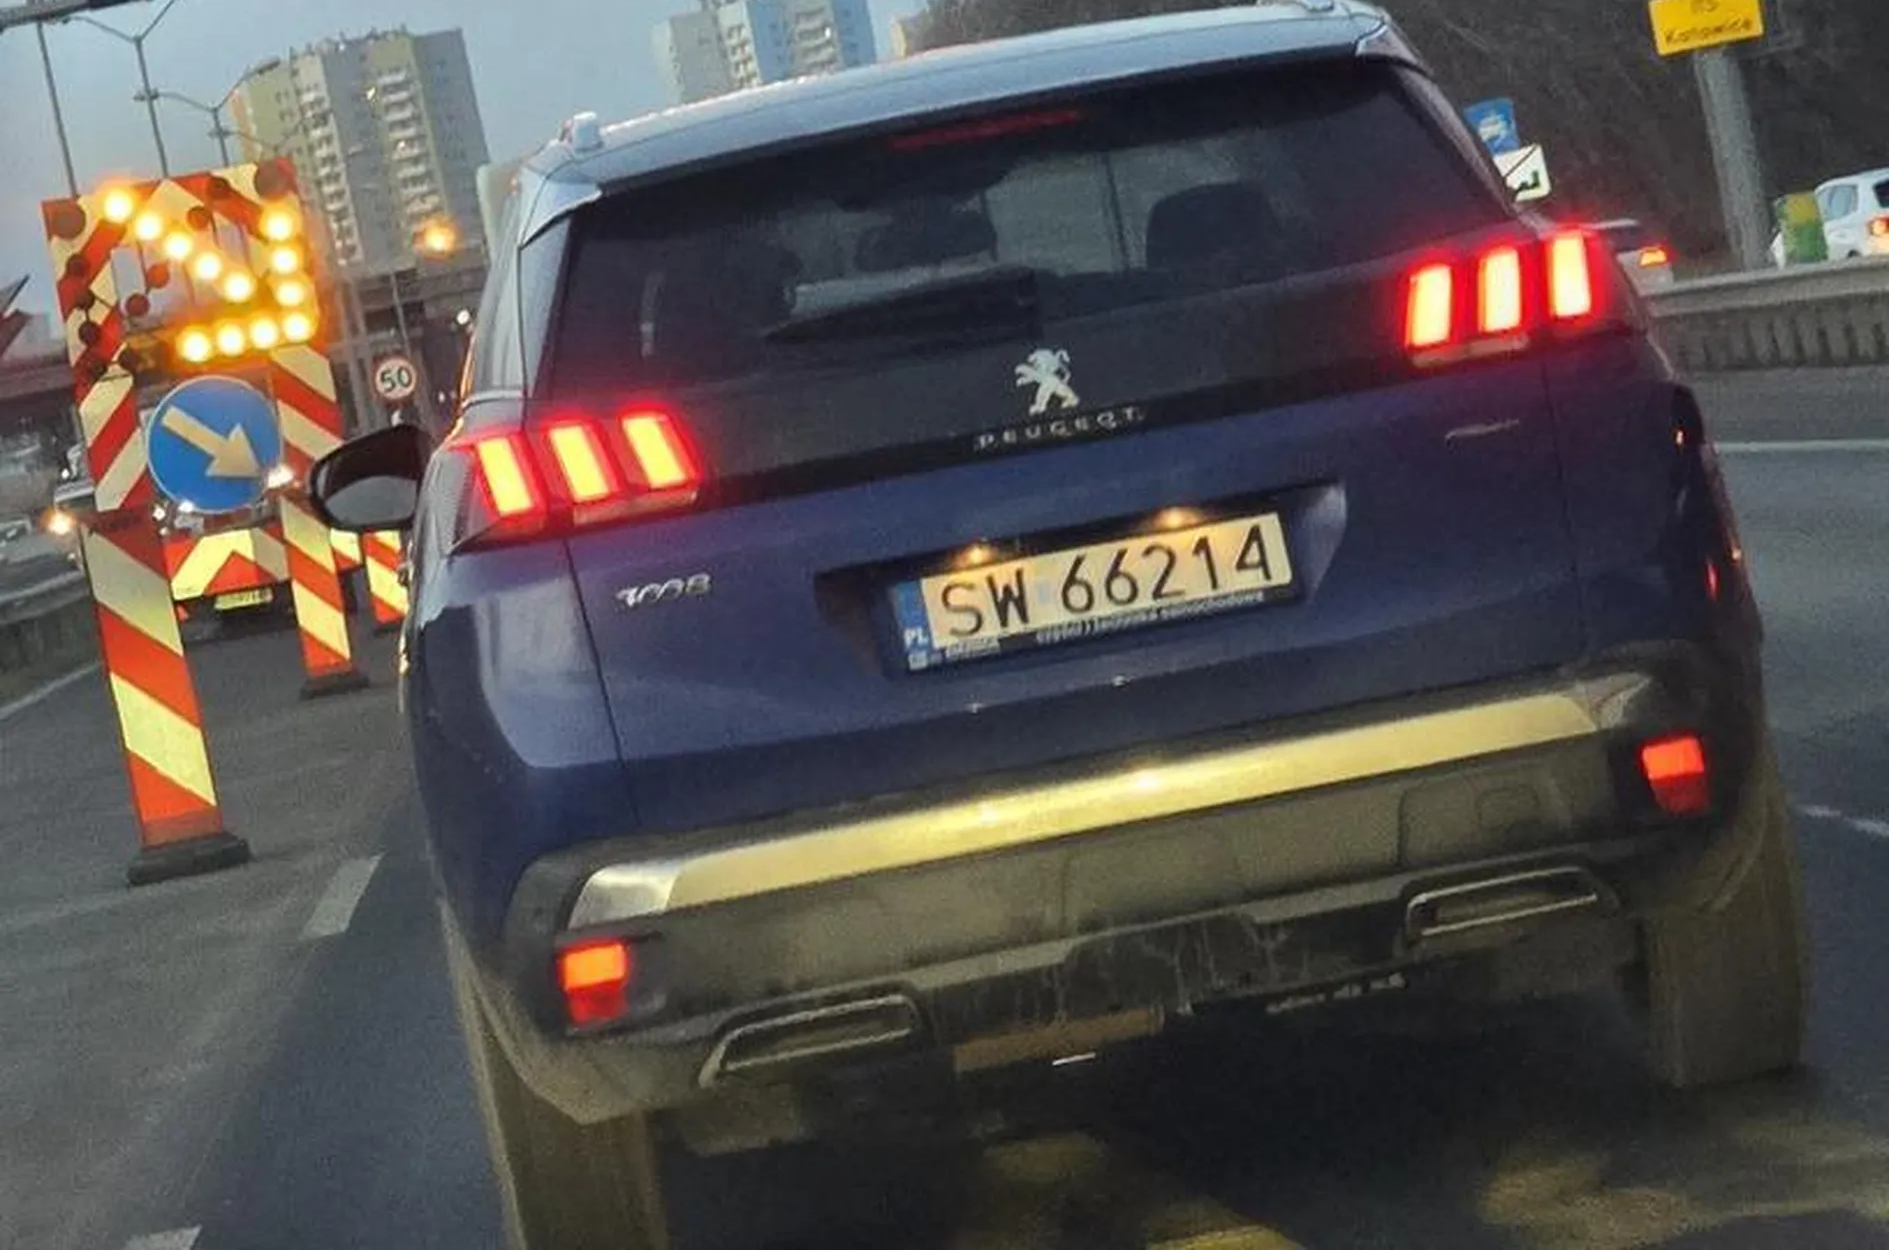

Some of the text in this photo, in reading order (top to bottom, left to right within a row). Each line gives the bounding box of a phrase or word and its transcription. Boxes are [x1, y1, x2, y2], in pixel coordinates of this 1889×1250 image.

[380, 366, 413, 392] 50
[976, 406, 1140, 450] PEUGEOT
[940, 567, 1030, 637] SW
[1060, 523, 1274, 615] 66214
[904, 627, 929, 648] PL
